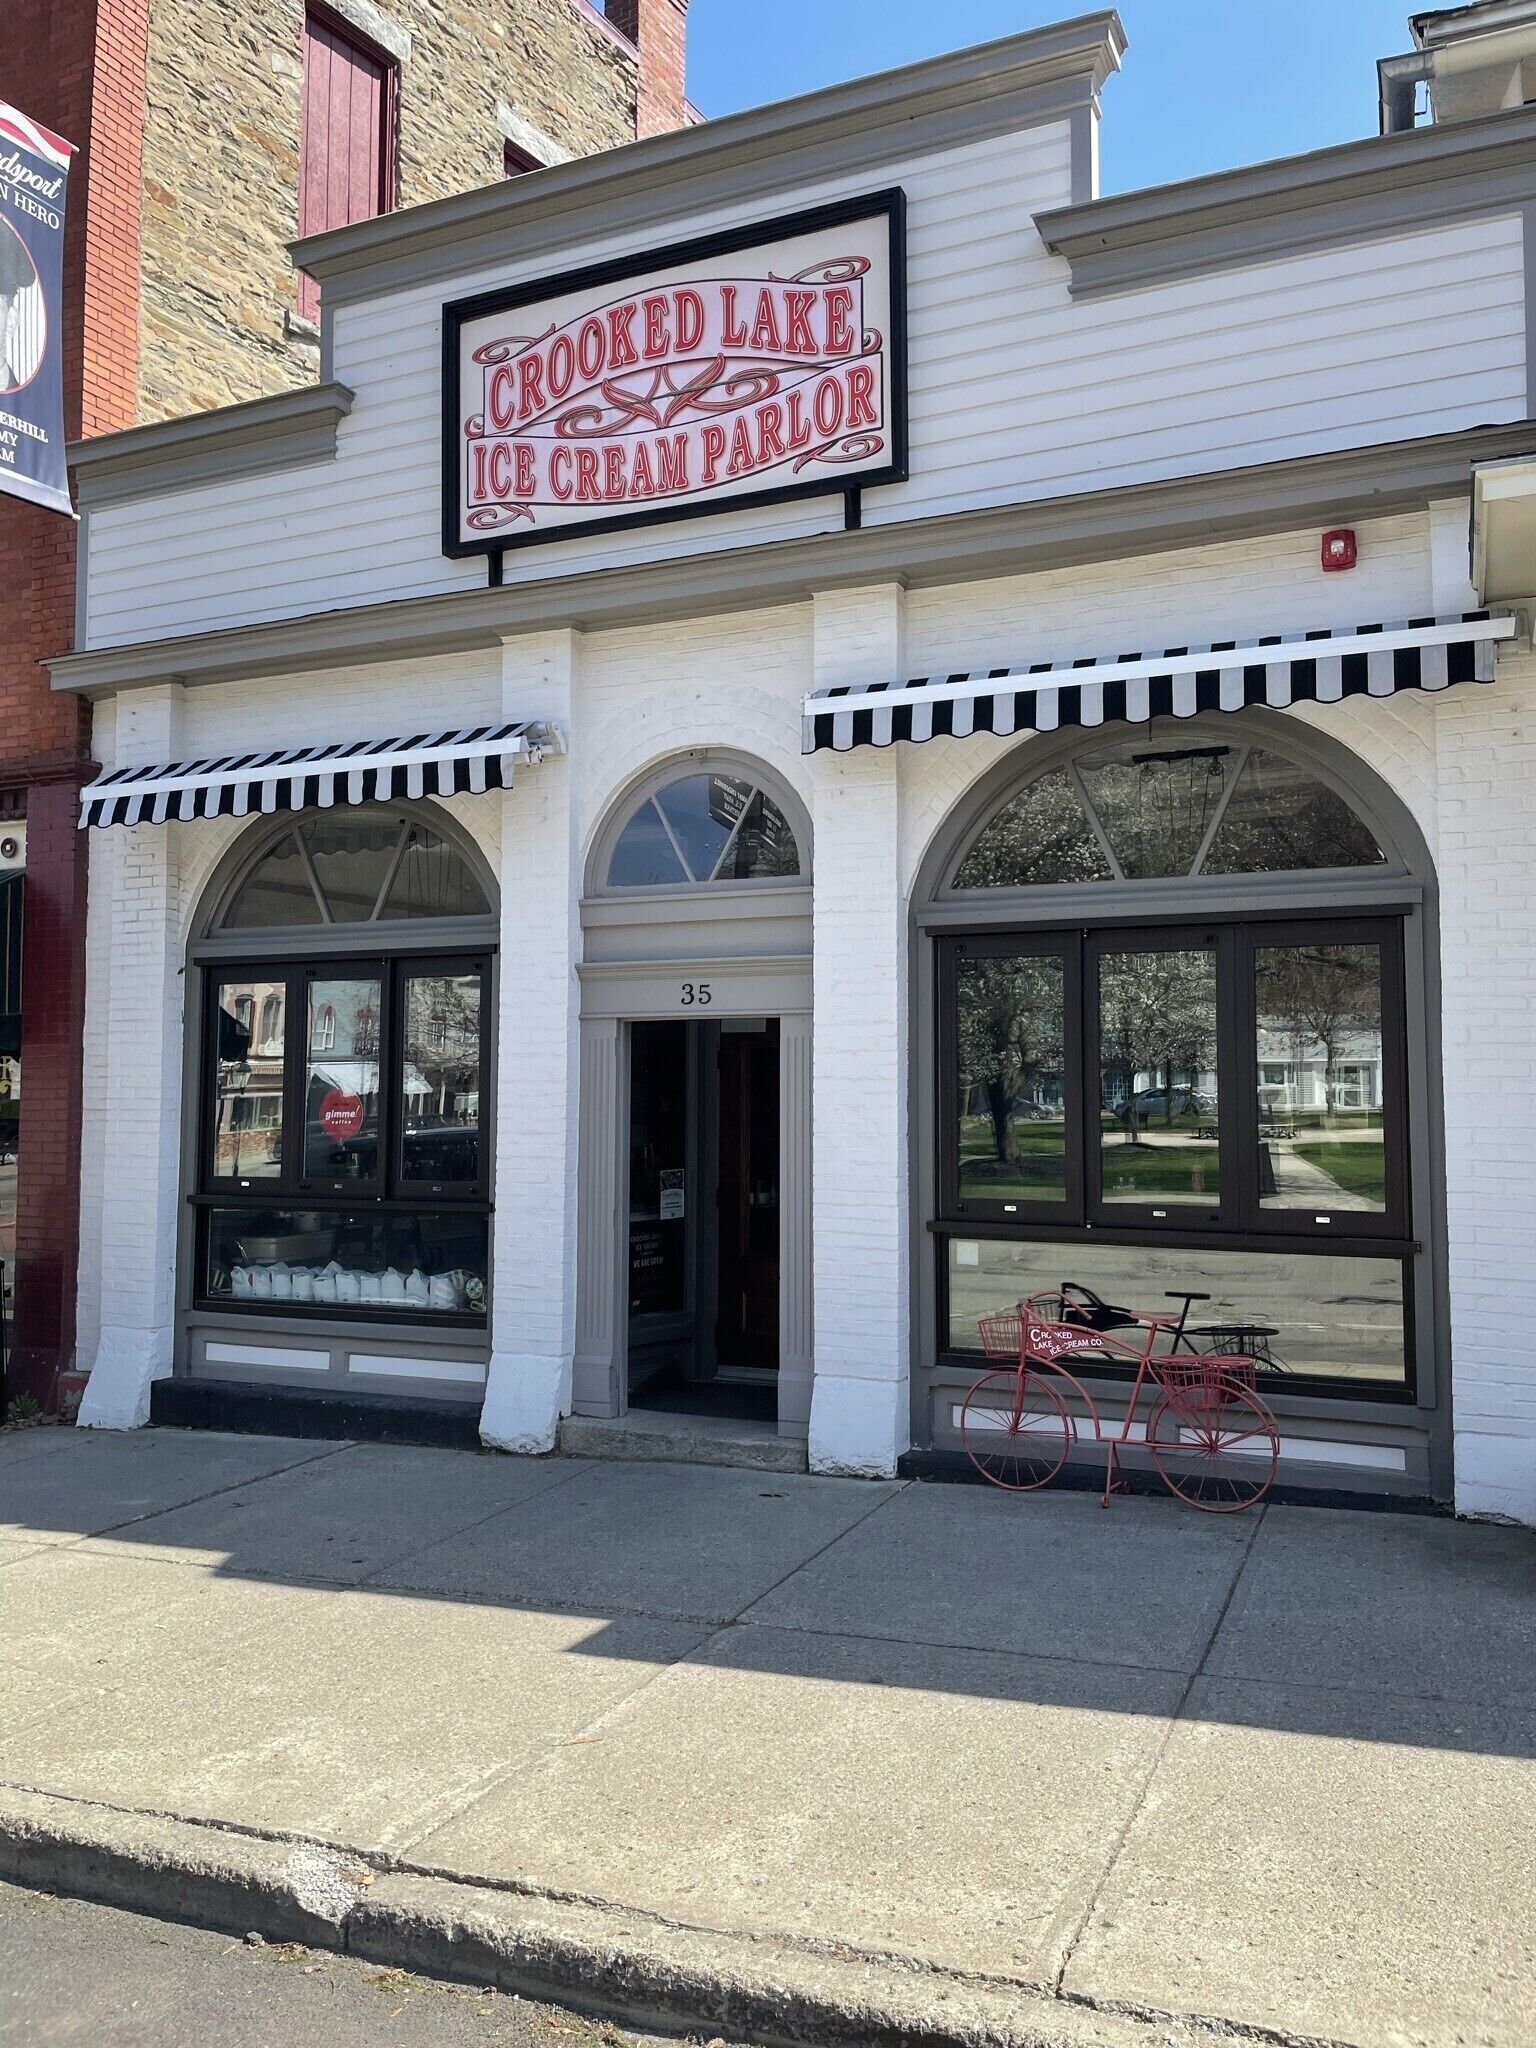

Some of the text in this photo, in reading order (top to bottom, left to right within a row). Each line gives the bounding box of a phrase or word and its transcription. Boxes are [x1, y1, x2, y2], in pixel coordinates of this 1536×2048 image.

[0, 152, 63, 199] dsport
[13, 190, 60, 230] HERO
[489, 285, 853, 429] CROOKED LAKE
[473, 365, 874, 500] ICE CREAM PARLOR
[680, 983, 712, 1005] 35
[1030, 1329, 1073, 1342] CROKED
[1033, 1341, 1053, 1350] LAKE
[1049, 1345, 1063, 1356] ICE
